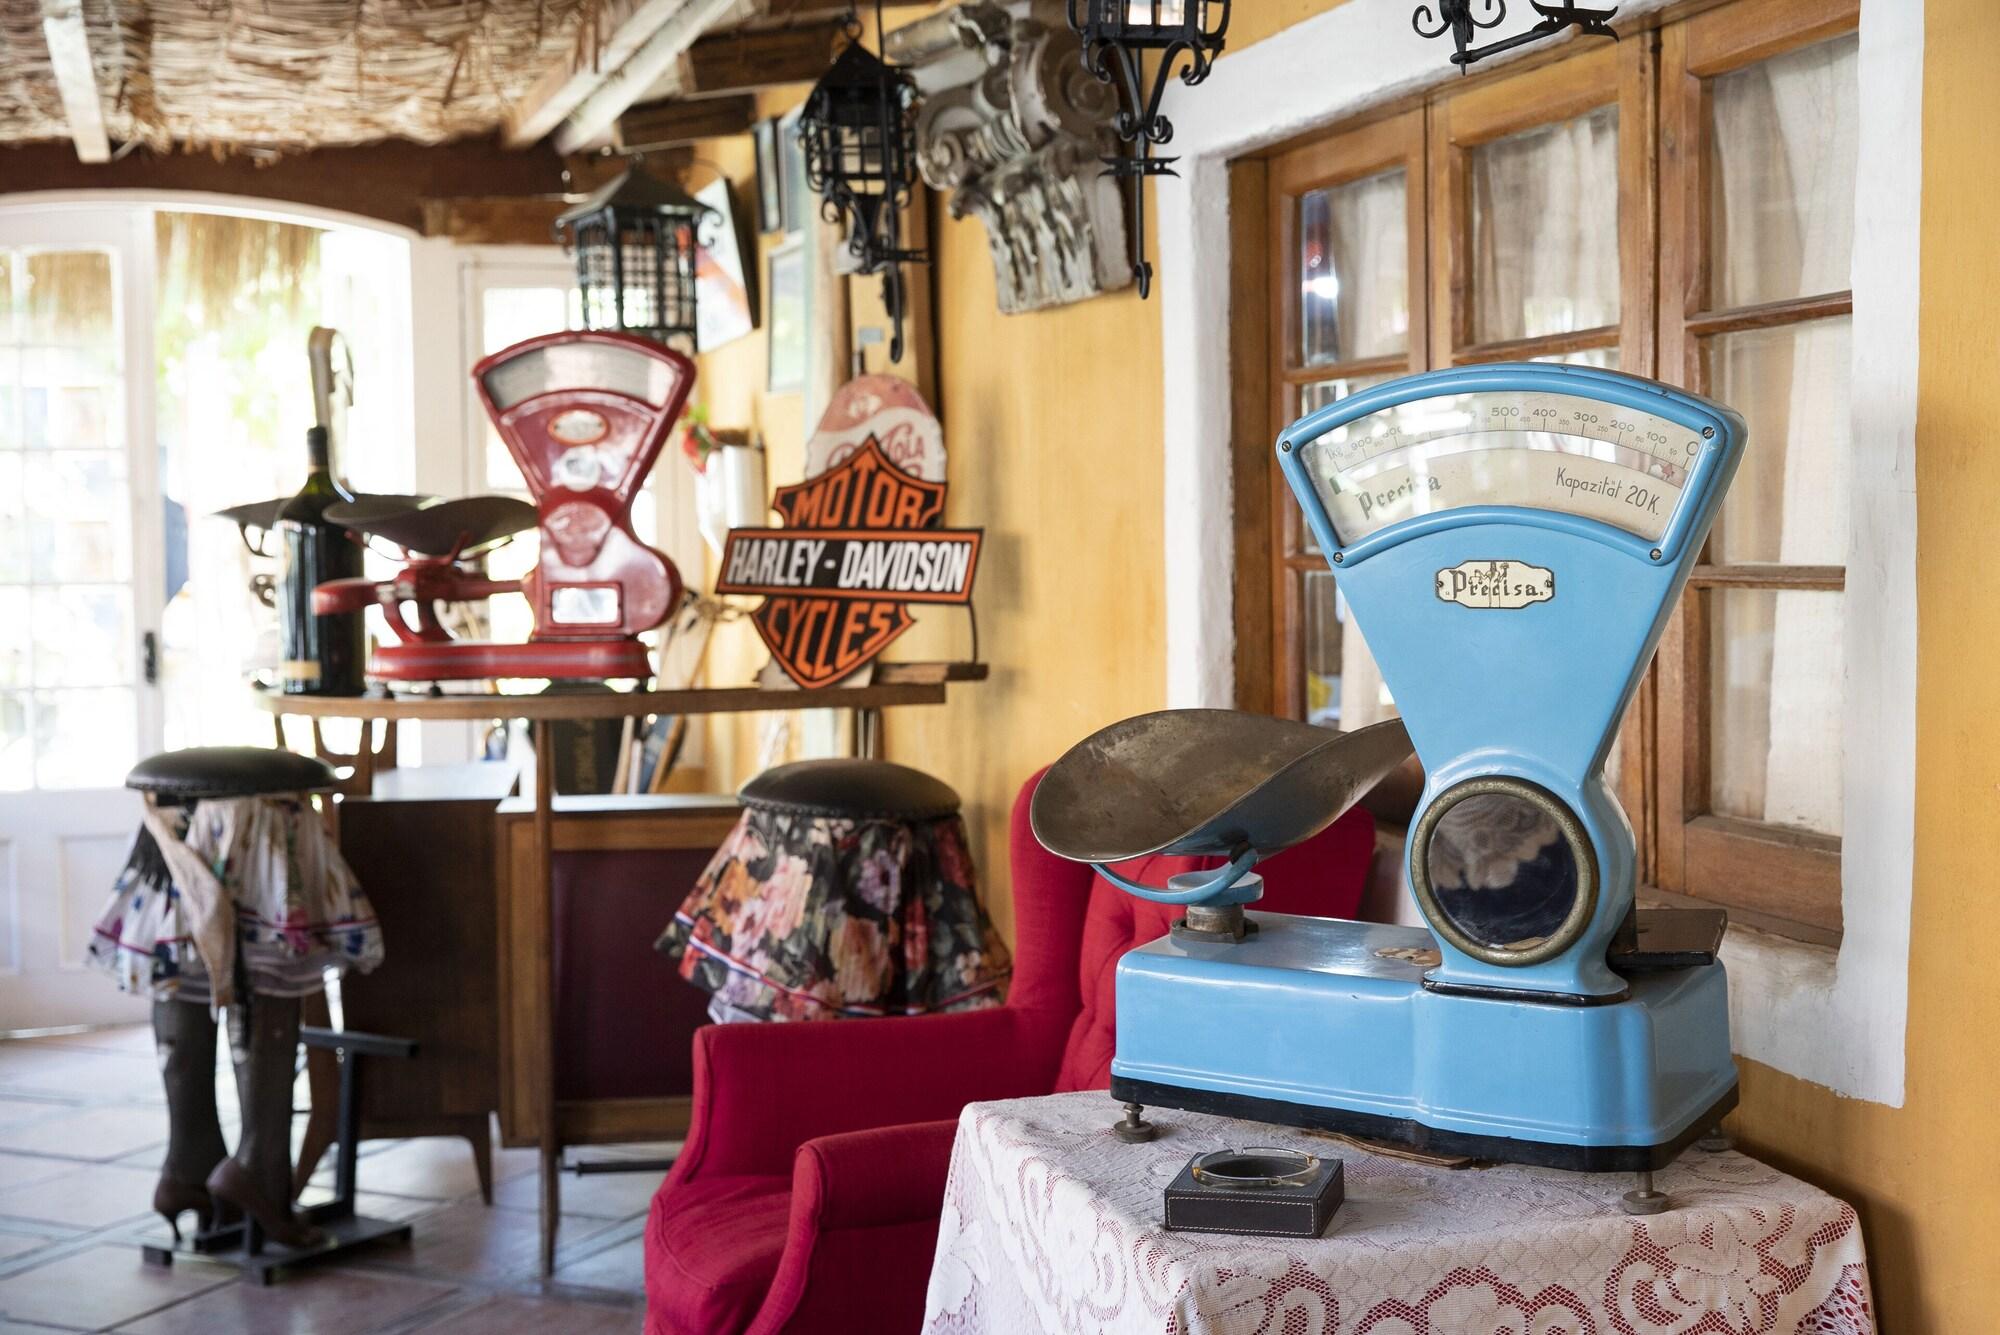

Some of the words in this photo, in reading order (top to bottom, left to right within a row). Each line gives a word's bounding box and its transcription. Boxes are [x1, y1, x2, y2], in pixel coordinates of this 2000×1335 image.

[1491, 407, 1520, 417] 500
[1532, 409, 1557, 418] 400
[1573, 411, 1598, 424] 300
[1609, 420, 1635, 432] 200
[1646, 431, 1668, 444] 100
[790, 449, 925, 529] MOTOR
[766, 600, 895, 681] CYCLES
